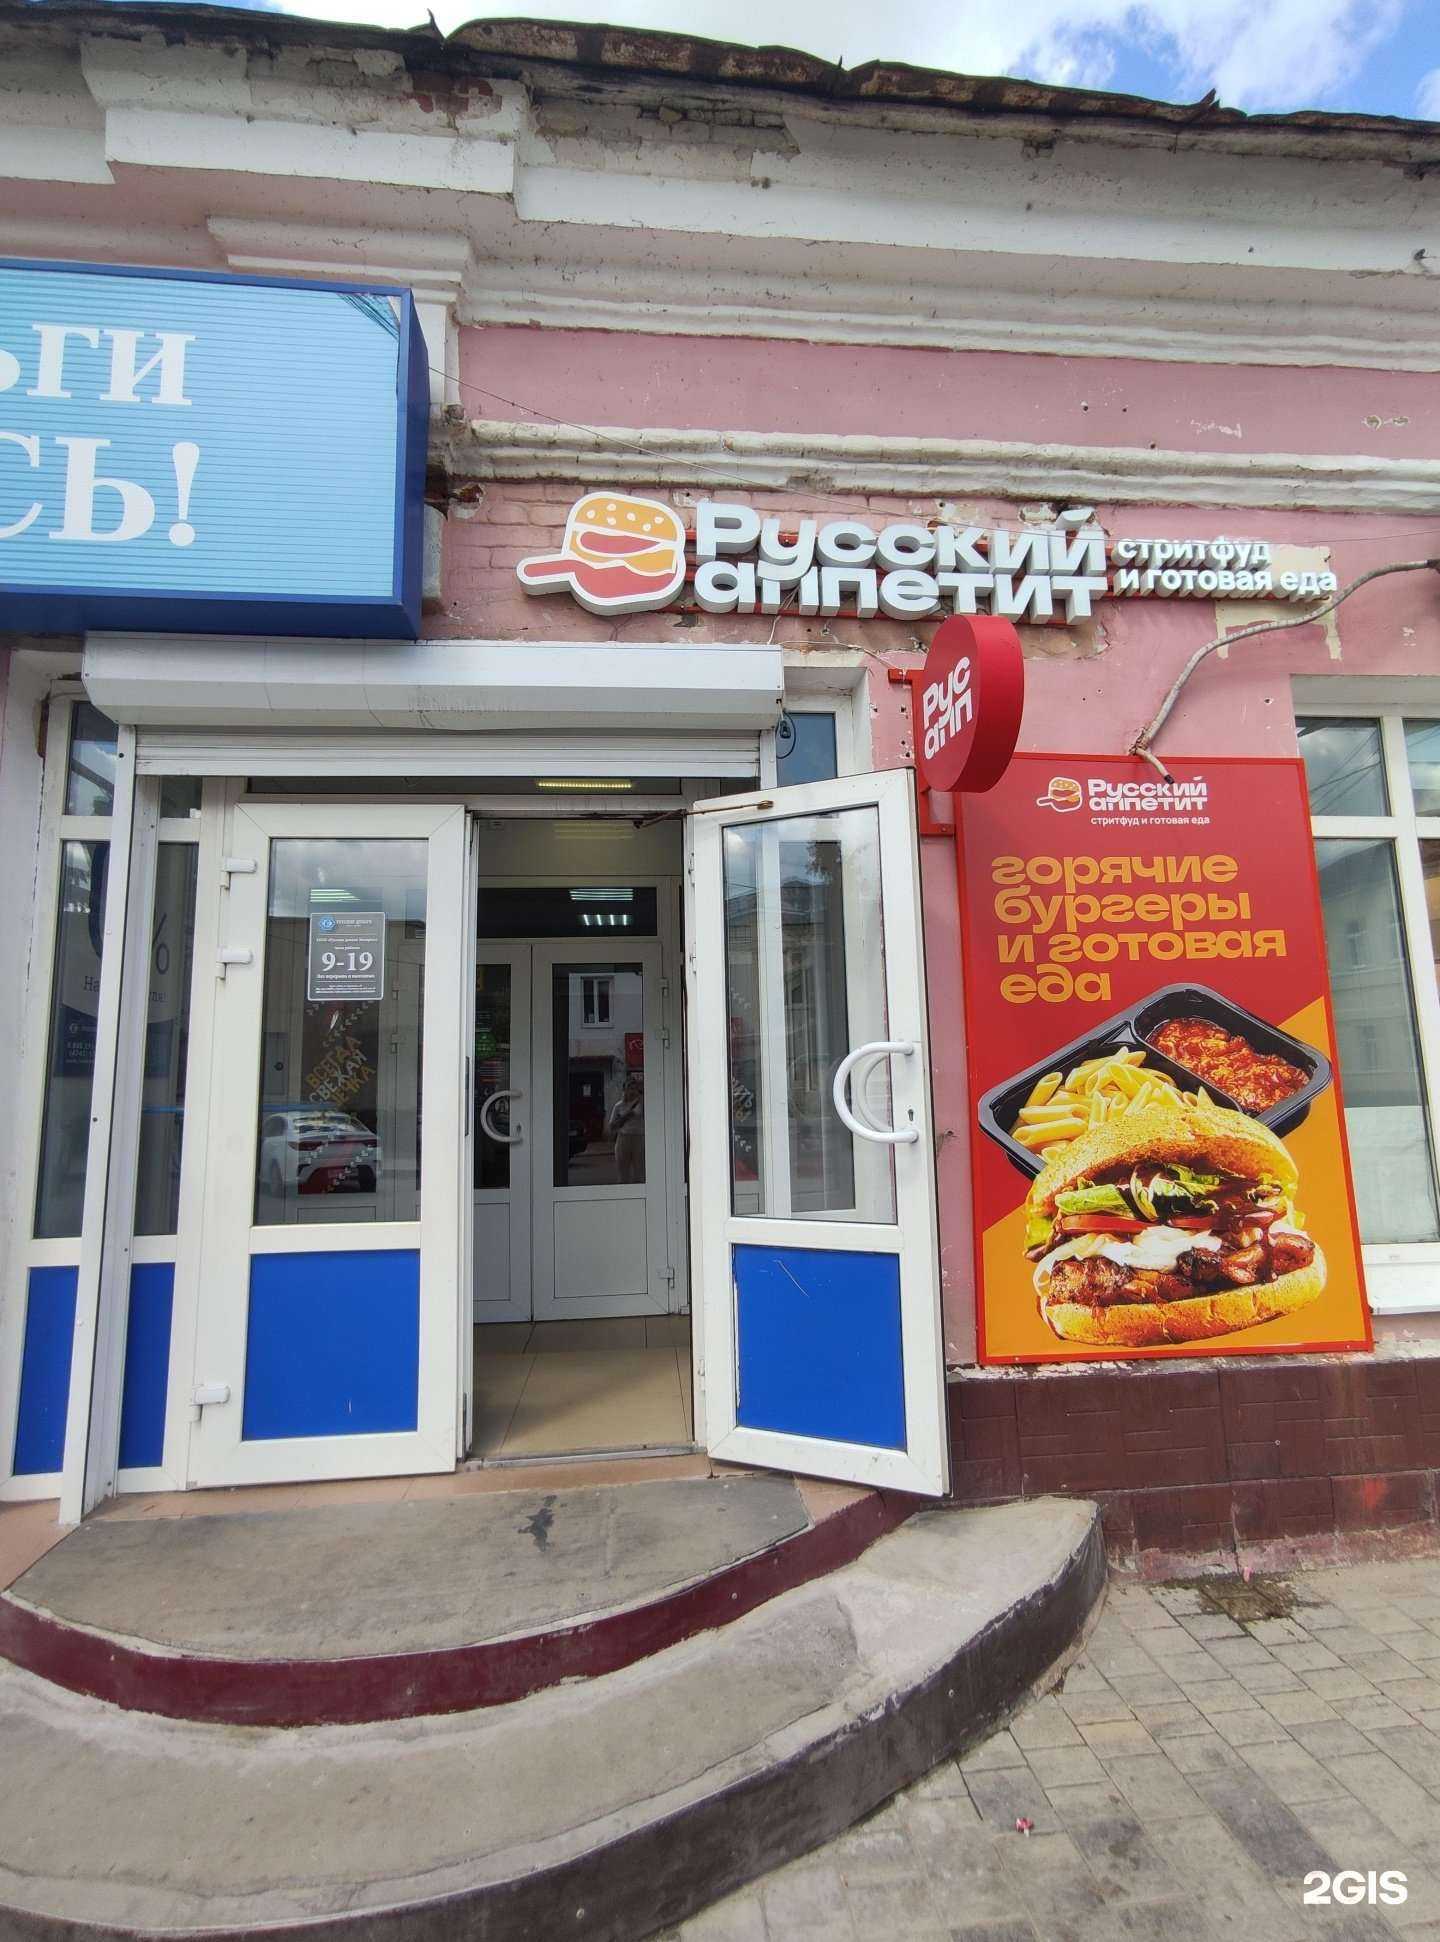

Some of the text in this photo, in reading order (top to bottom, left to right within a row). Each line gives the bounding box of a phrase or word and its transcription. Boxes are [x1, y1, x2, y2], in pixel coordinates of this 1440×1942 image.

[0, 323, 196, 406] ГИ
[695, 502, 1107, 579] Русский
[1115, 535, 1272, 570] стритфуд
[694, 560, 1108, 623] аппетит
[1118, 568, 1338, 597] и готовая еда
[922, 656, 971, 731] Рус
[1087, 775, 1208, 800] Русский
[1089, 796, 1208, 811] аппетит
[1090, 815, 1210, 827] стритфуд и готовая еда
[991, 854, 1239, 894] горячие
[993, 885, 1252, 934] бургеры
[321, 951, 374, 972] 9-19
[998, 929, 1288, 963] и готовая
[999, 963, 1112, 1004] еда
